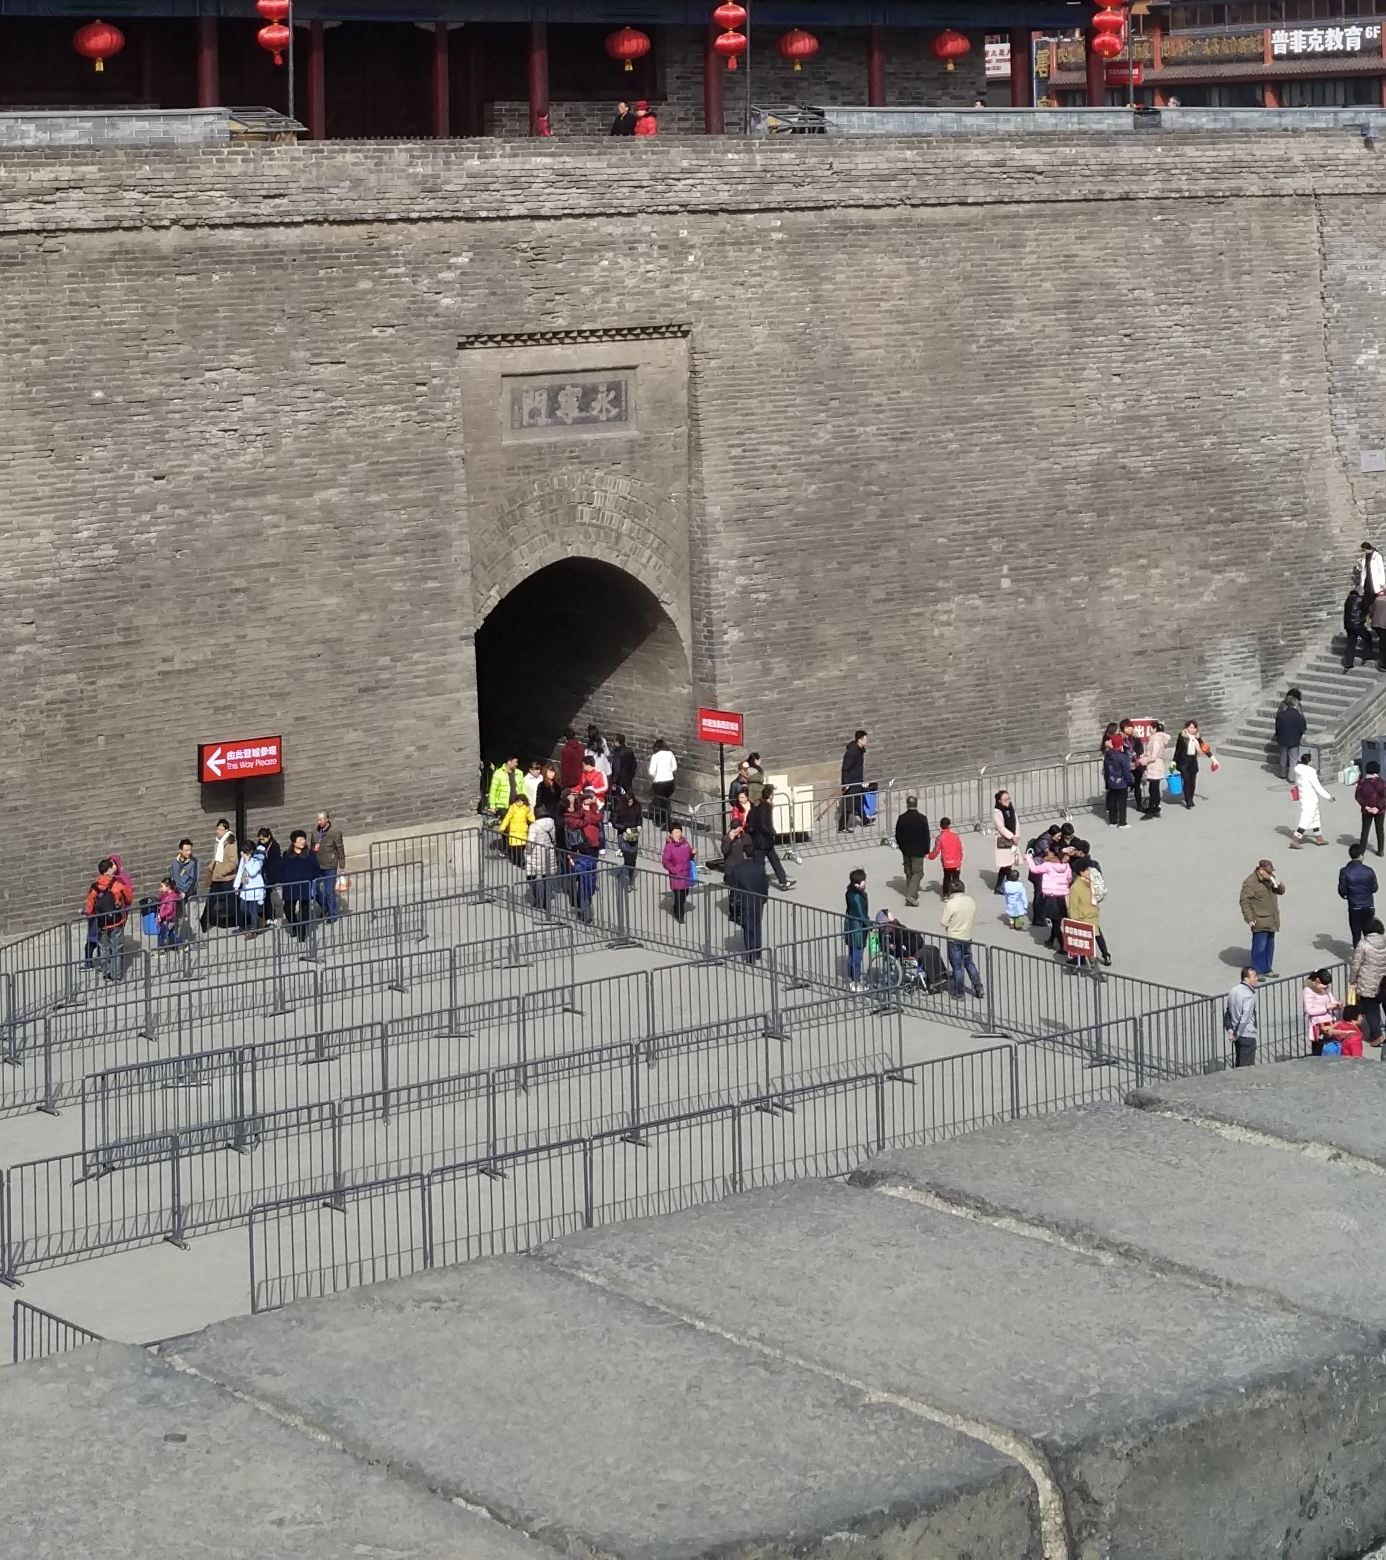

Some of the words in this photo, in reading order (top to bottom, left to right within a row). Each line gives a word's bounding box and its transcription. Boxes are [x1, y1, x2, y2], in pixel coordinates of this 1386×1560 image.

[1365, 26, 1381, 39] 6F
[1271, 26, 1363, 55] 普菲克教育
[240, 760, 254, 769] Way
